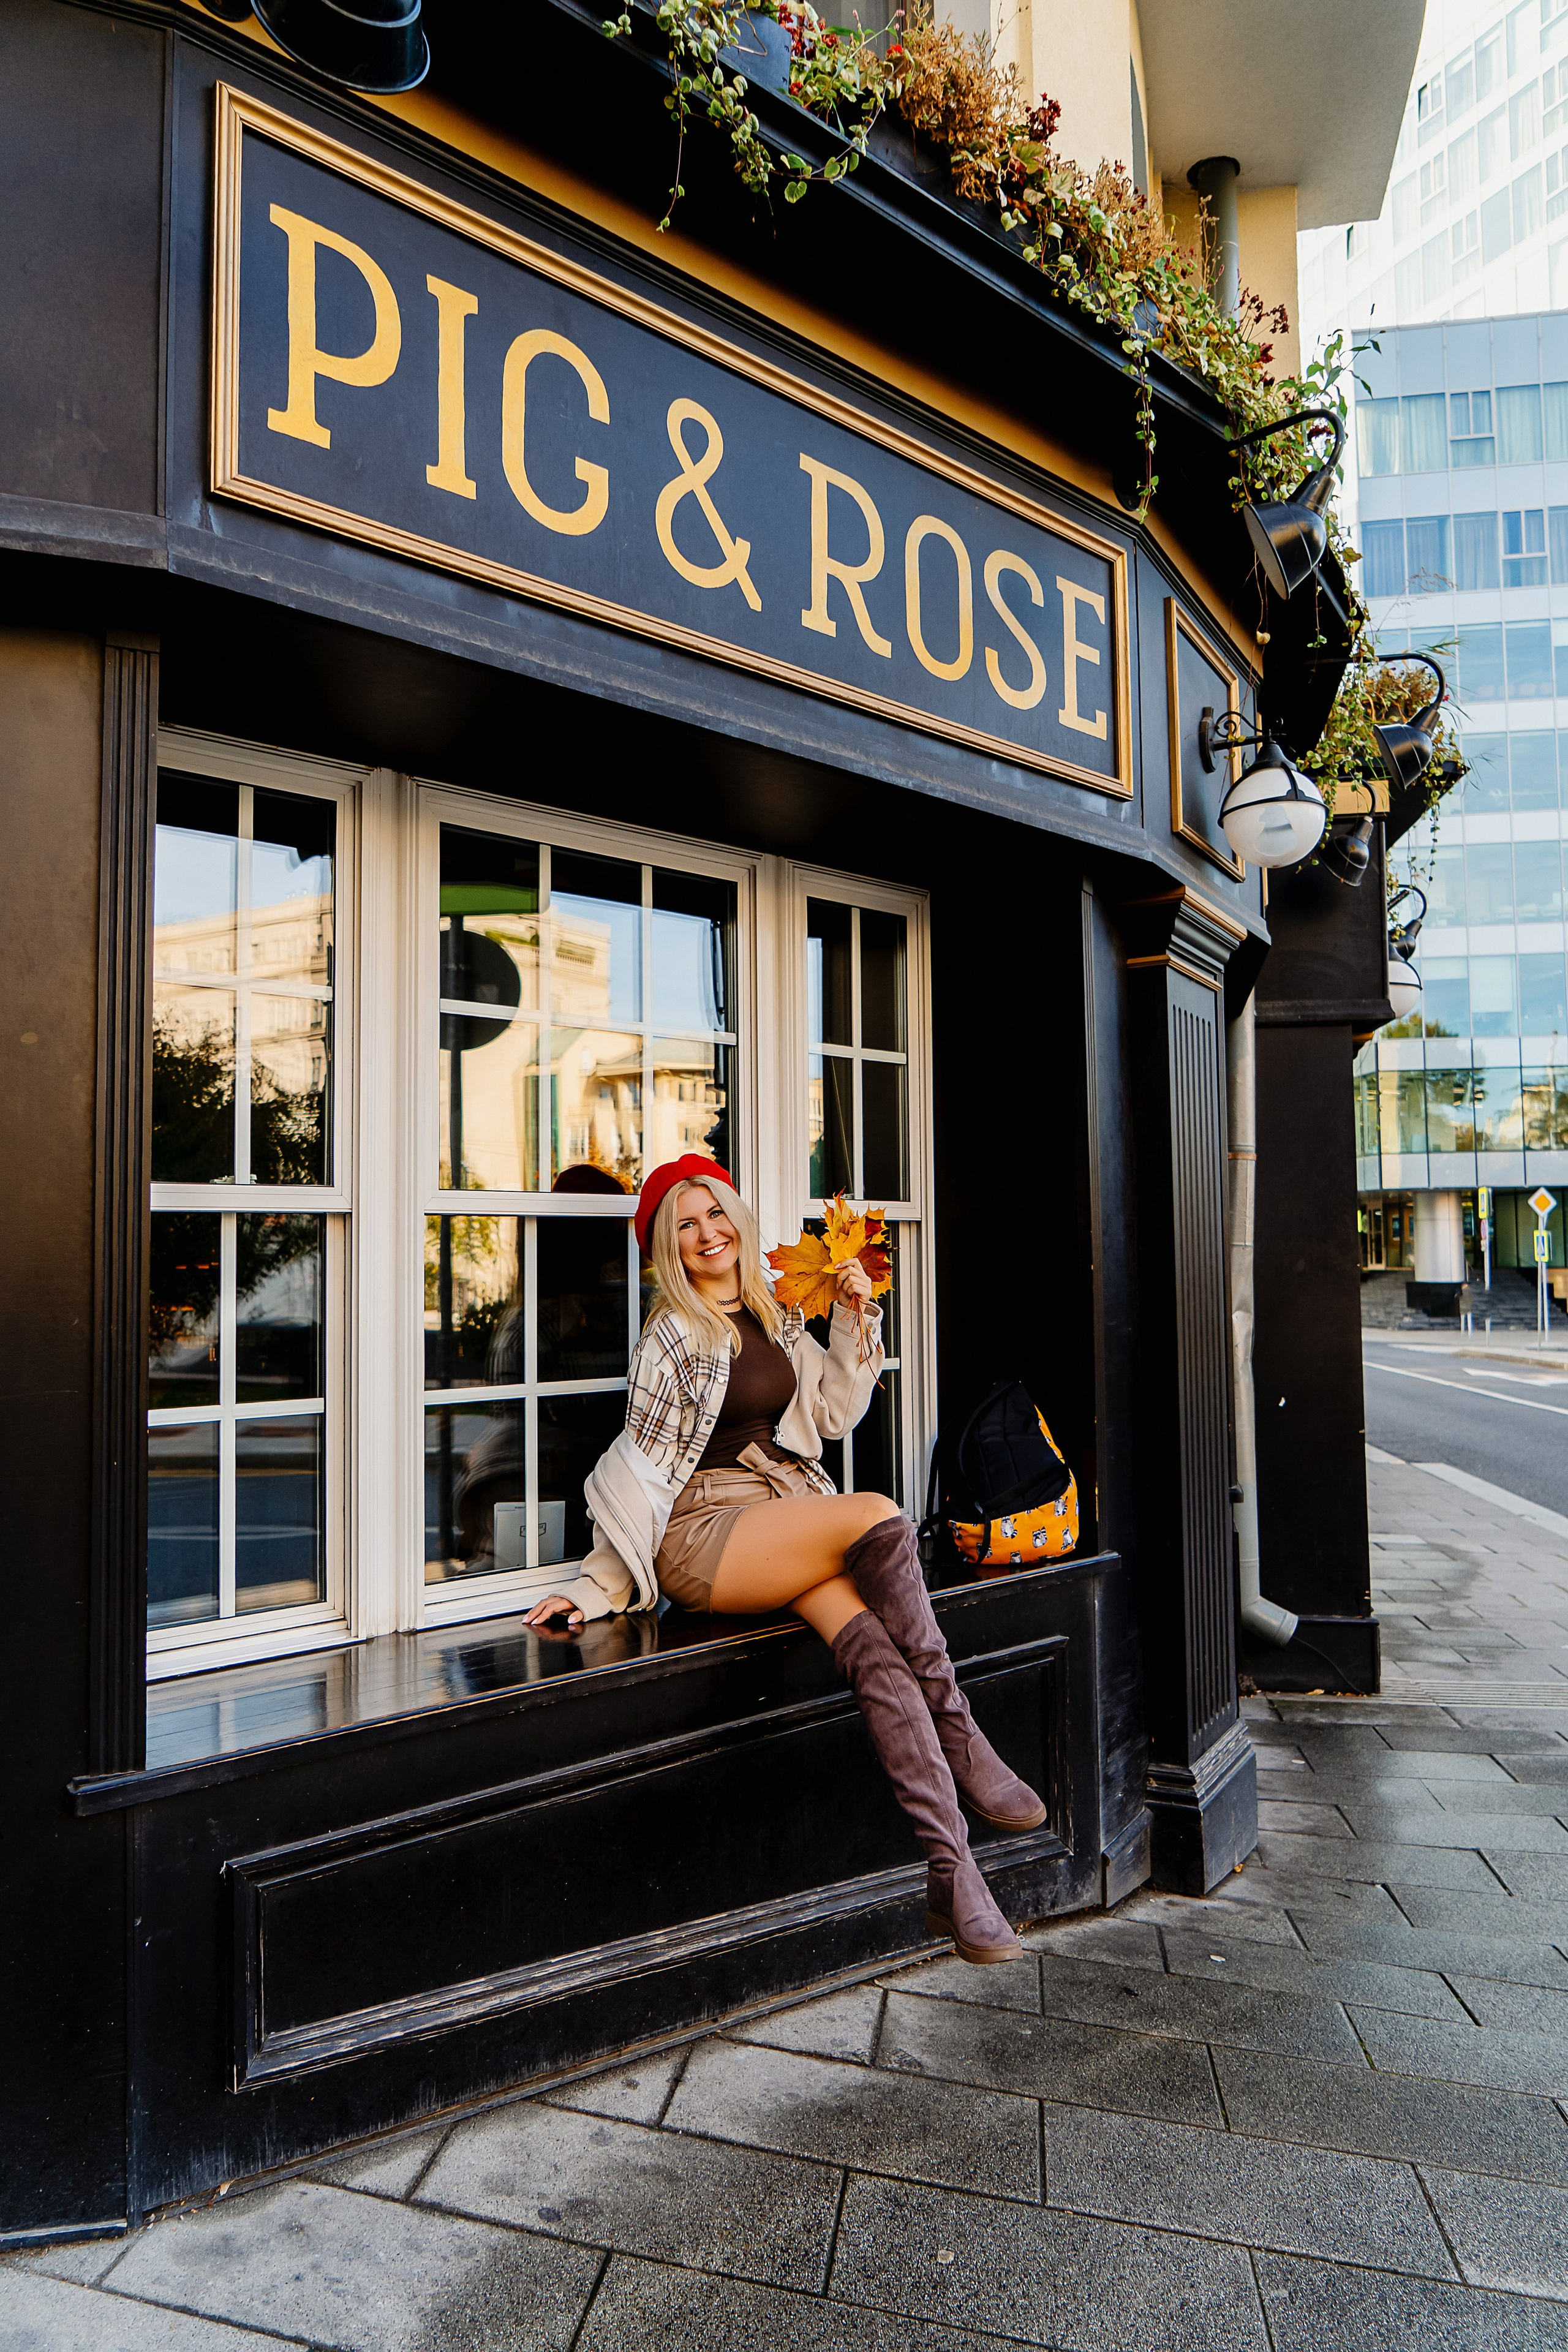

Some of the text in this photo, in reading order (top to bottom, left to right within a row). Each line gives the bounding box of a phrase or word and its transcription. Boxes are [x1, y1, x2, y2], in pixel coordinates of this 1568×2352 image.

[266, 202, 1107, 741] PIG & ROSE
